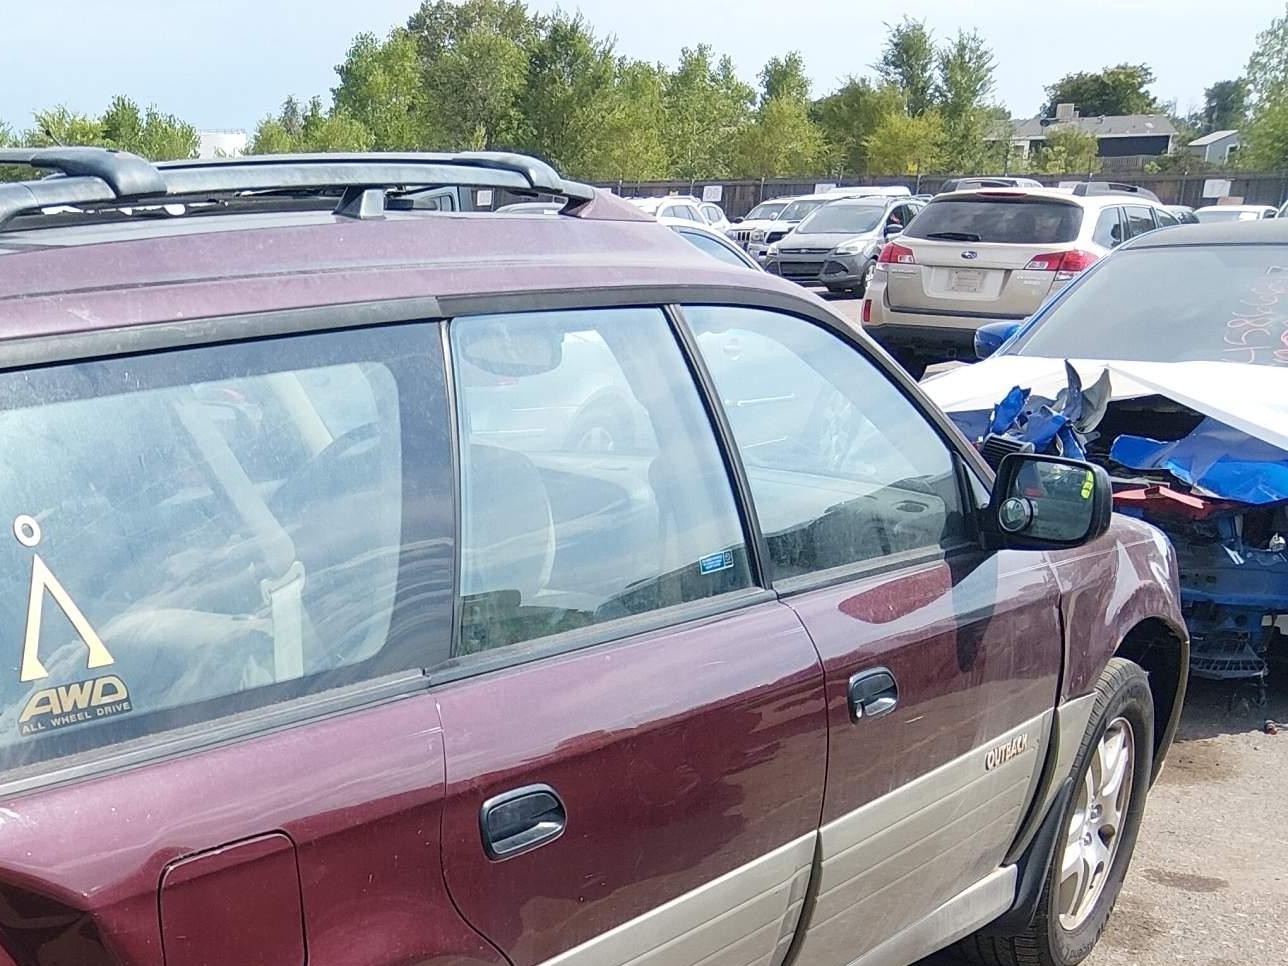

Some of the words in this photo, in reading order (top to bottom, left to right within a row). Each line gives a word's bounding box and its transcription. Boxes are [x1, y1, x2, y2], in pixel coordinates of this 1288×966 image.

[19, 675, 128, 723] AWD
[22, 723, 46, 734] ALL
[51, 711, 92, 727] WHEEL
[96, 702, 131, 716] DRIVE
[985, 734, 1029, 771] OUTBACK
